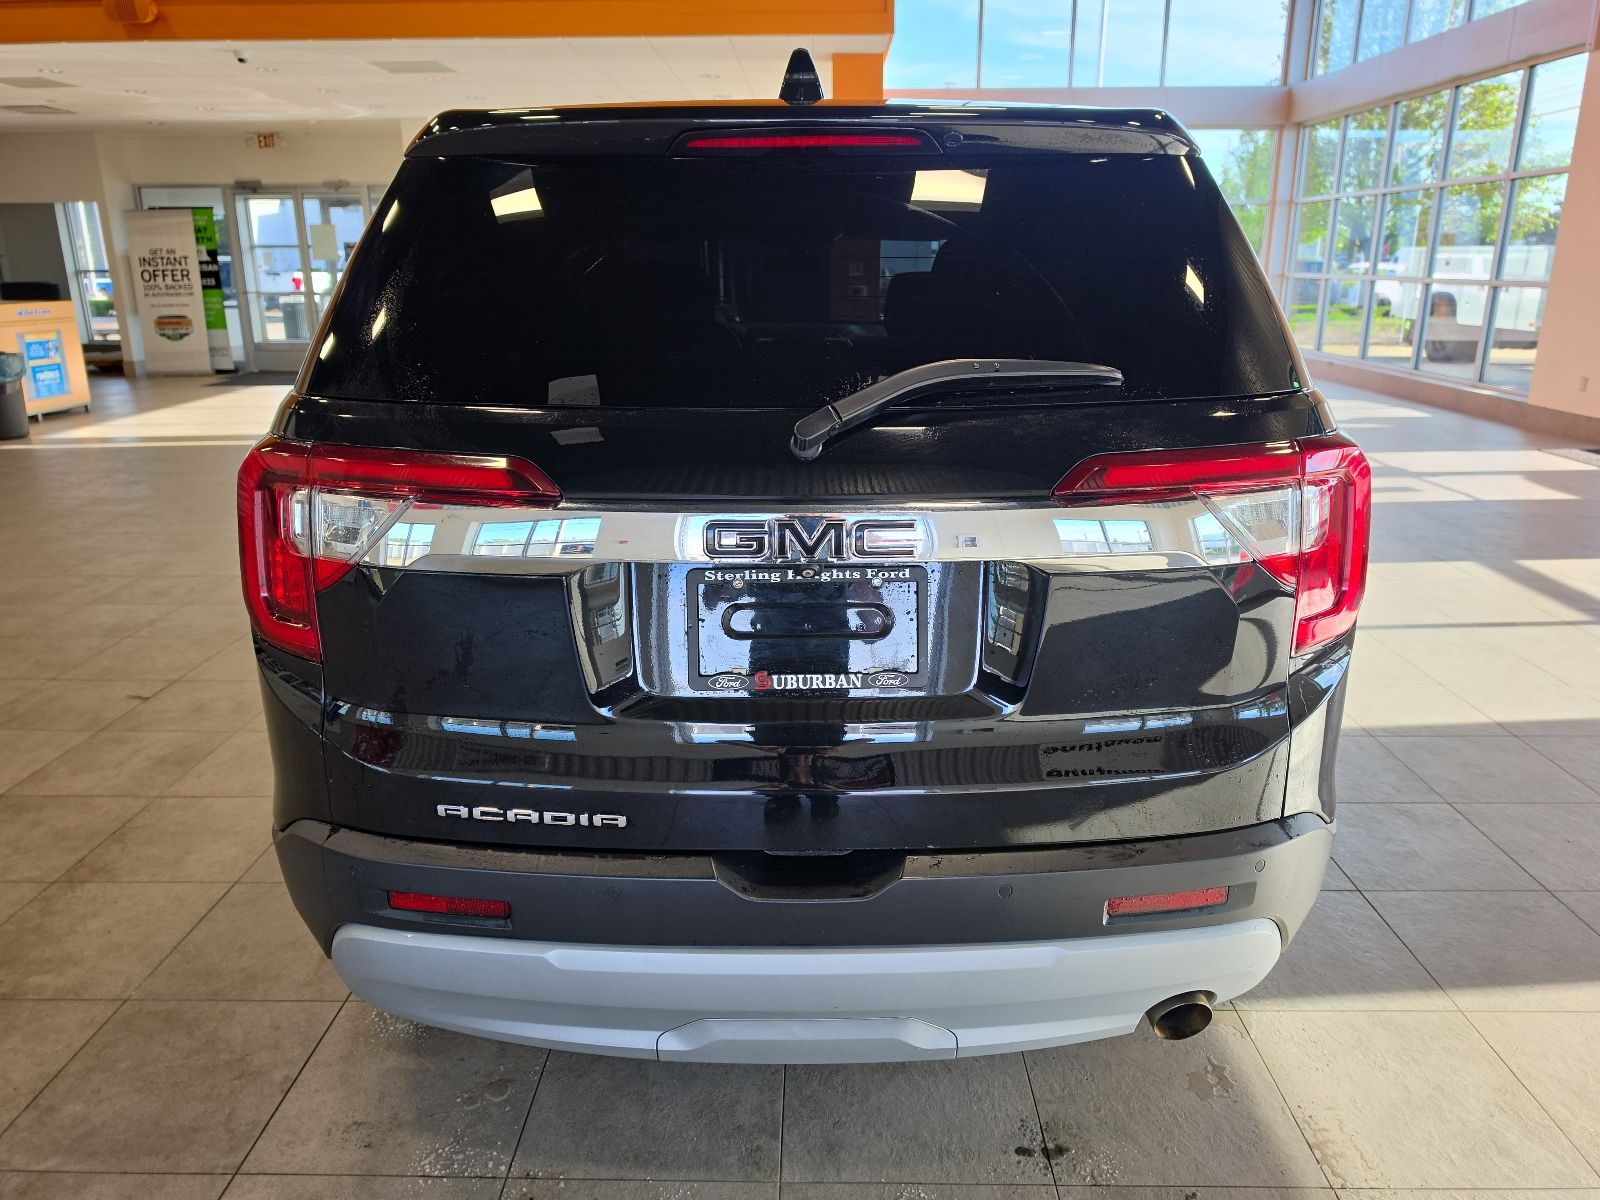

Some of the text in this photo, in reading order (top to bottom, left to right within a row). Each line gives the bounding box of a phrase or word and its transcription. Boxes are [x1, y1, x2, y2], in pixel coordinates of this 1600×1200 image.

[257, 133, 275, 149] EXIT
[149, 248, 163, 256] GET
[138, 256, 189, 268] INSTANT
[141, 268, 191, 283] OFFER
[703, 518, 918, 559] GMC
[704, 568, 911, 583] Sterling Hghts Ford
[753, 671, 863, 691] SUBURBAN
[436, 804, 628, 828] ACADIA
